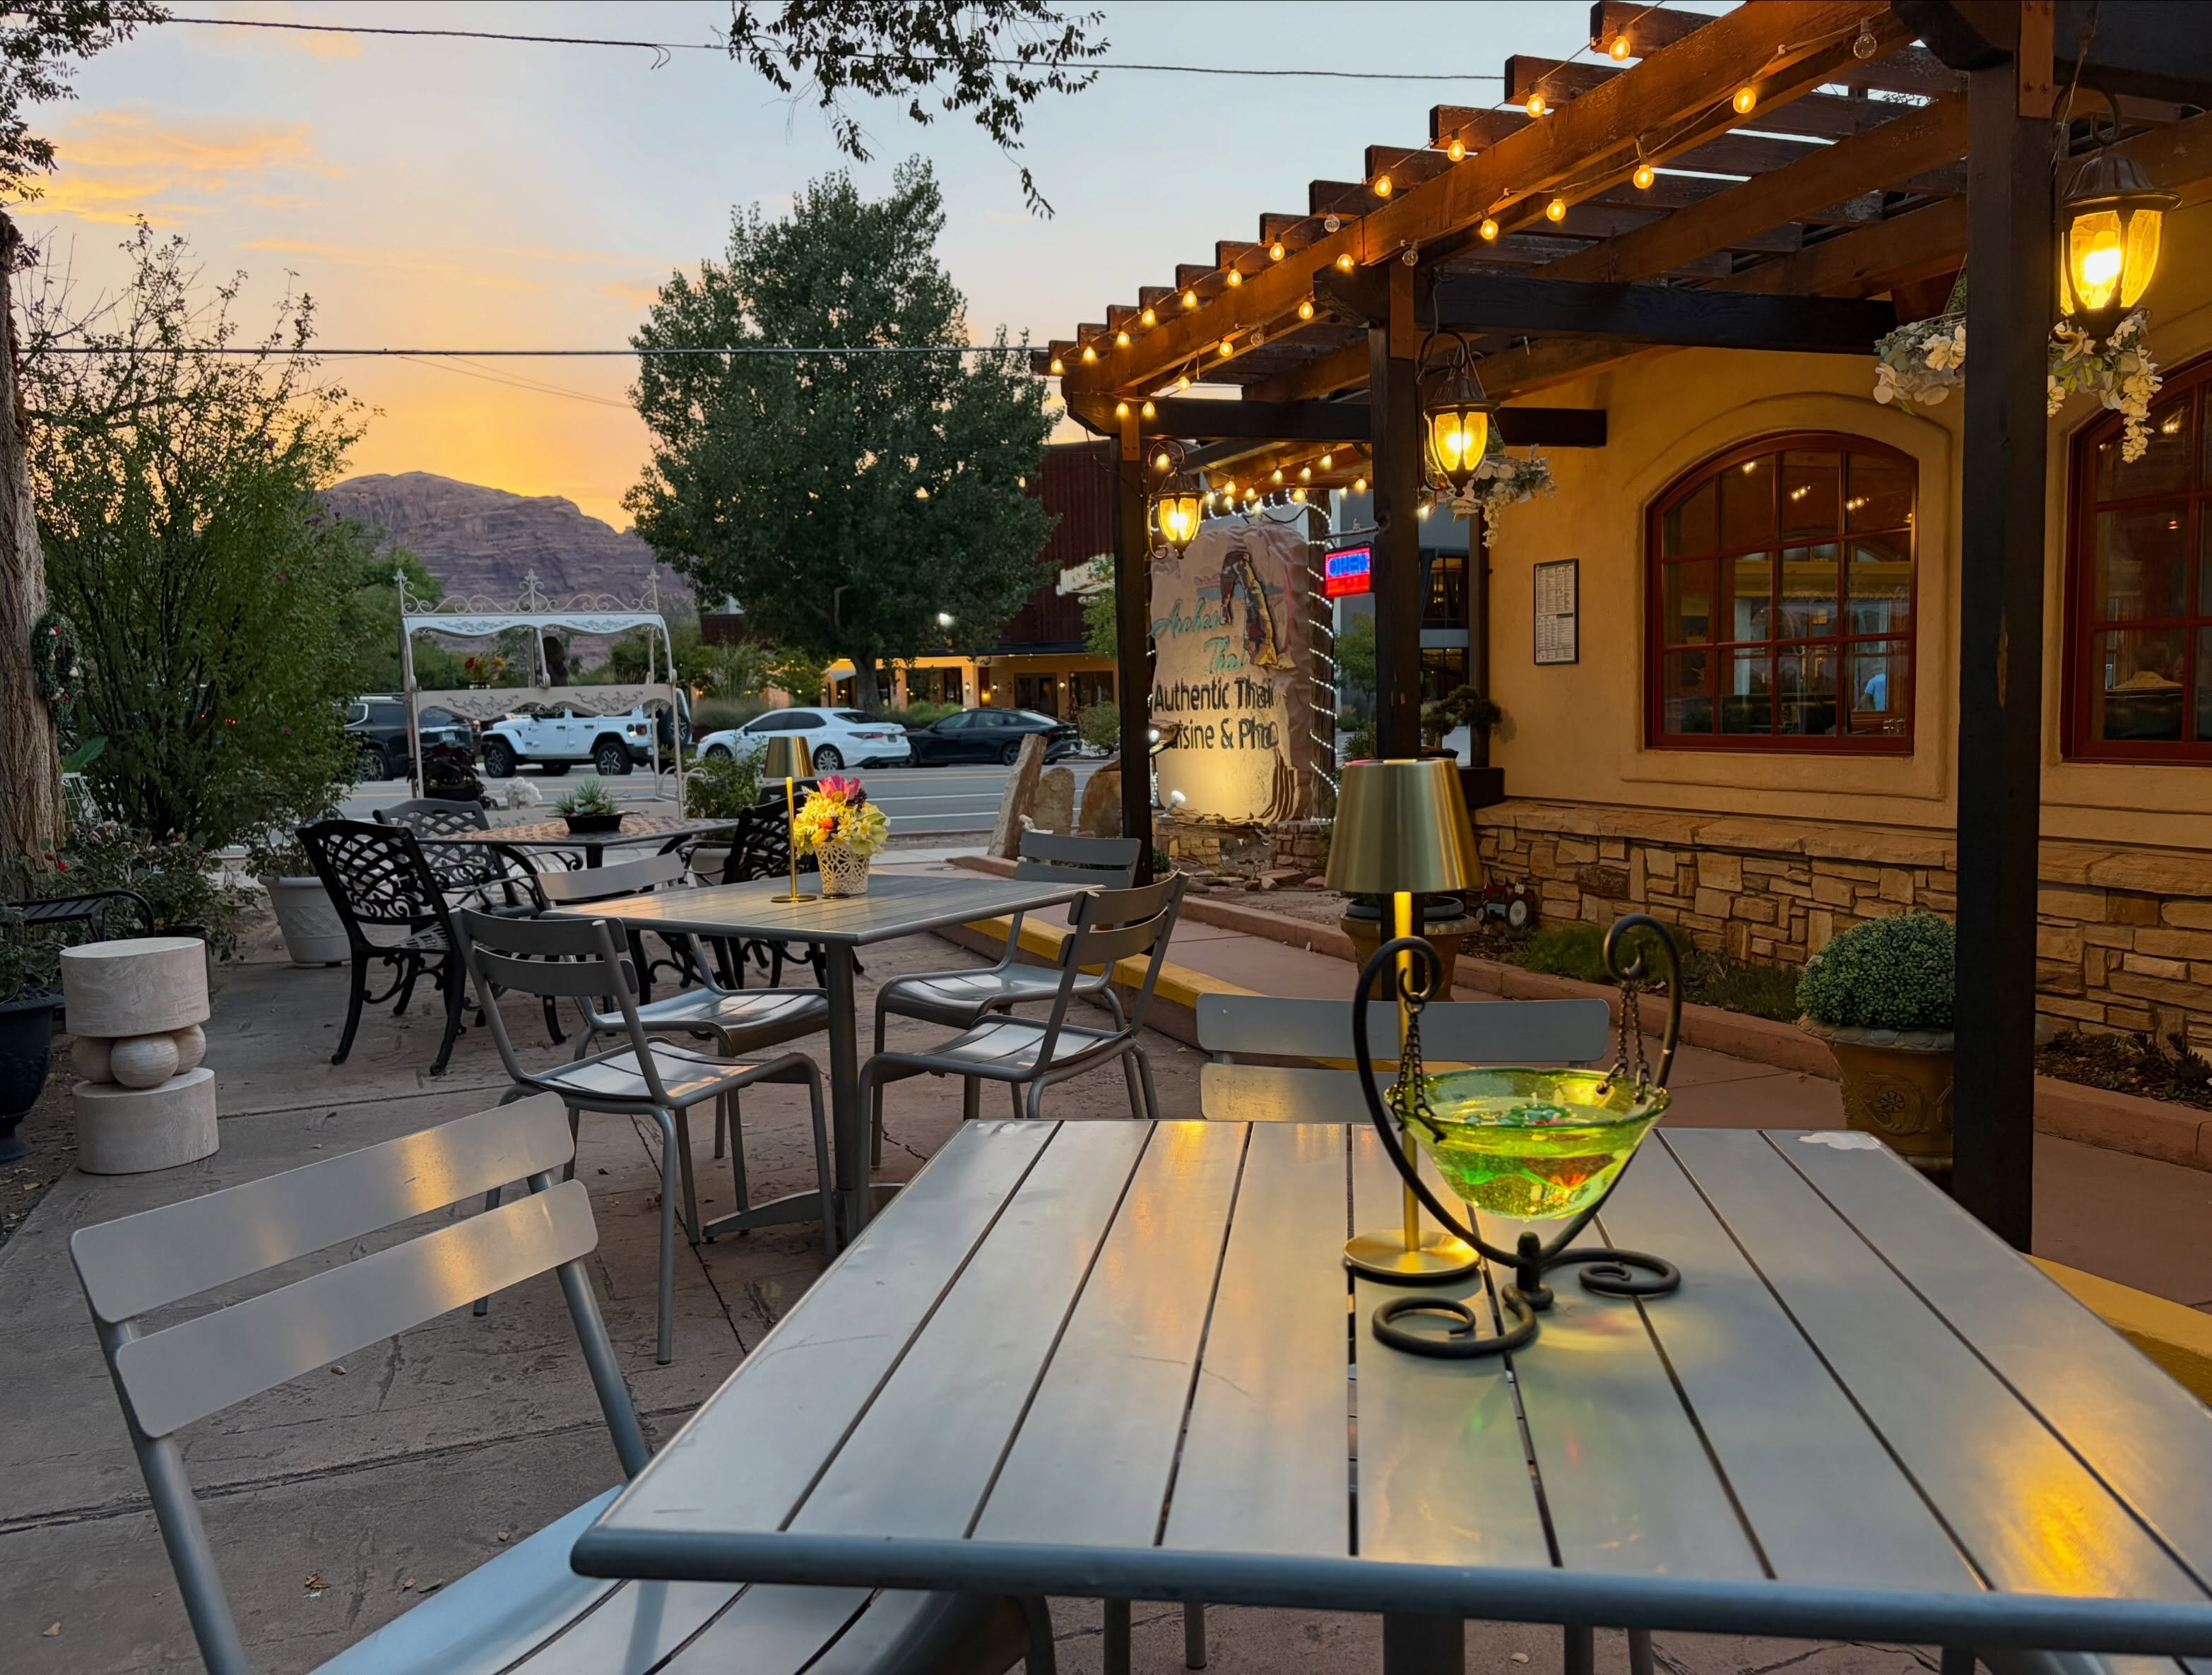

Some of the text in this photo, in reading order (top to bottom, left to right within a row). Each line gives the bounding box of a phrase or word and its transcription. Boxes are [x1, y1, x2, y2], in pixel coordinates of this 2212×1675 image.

[1329, 552, 1369, 577] OPEN
[1151, 598, 1220, 639] Arches
[1203, 635, 1248, 674] Thai
[1154, 675, 1274, 712] Authentic Thai
[1169, 716, 1279, 750] isine & Pho
